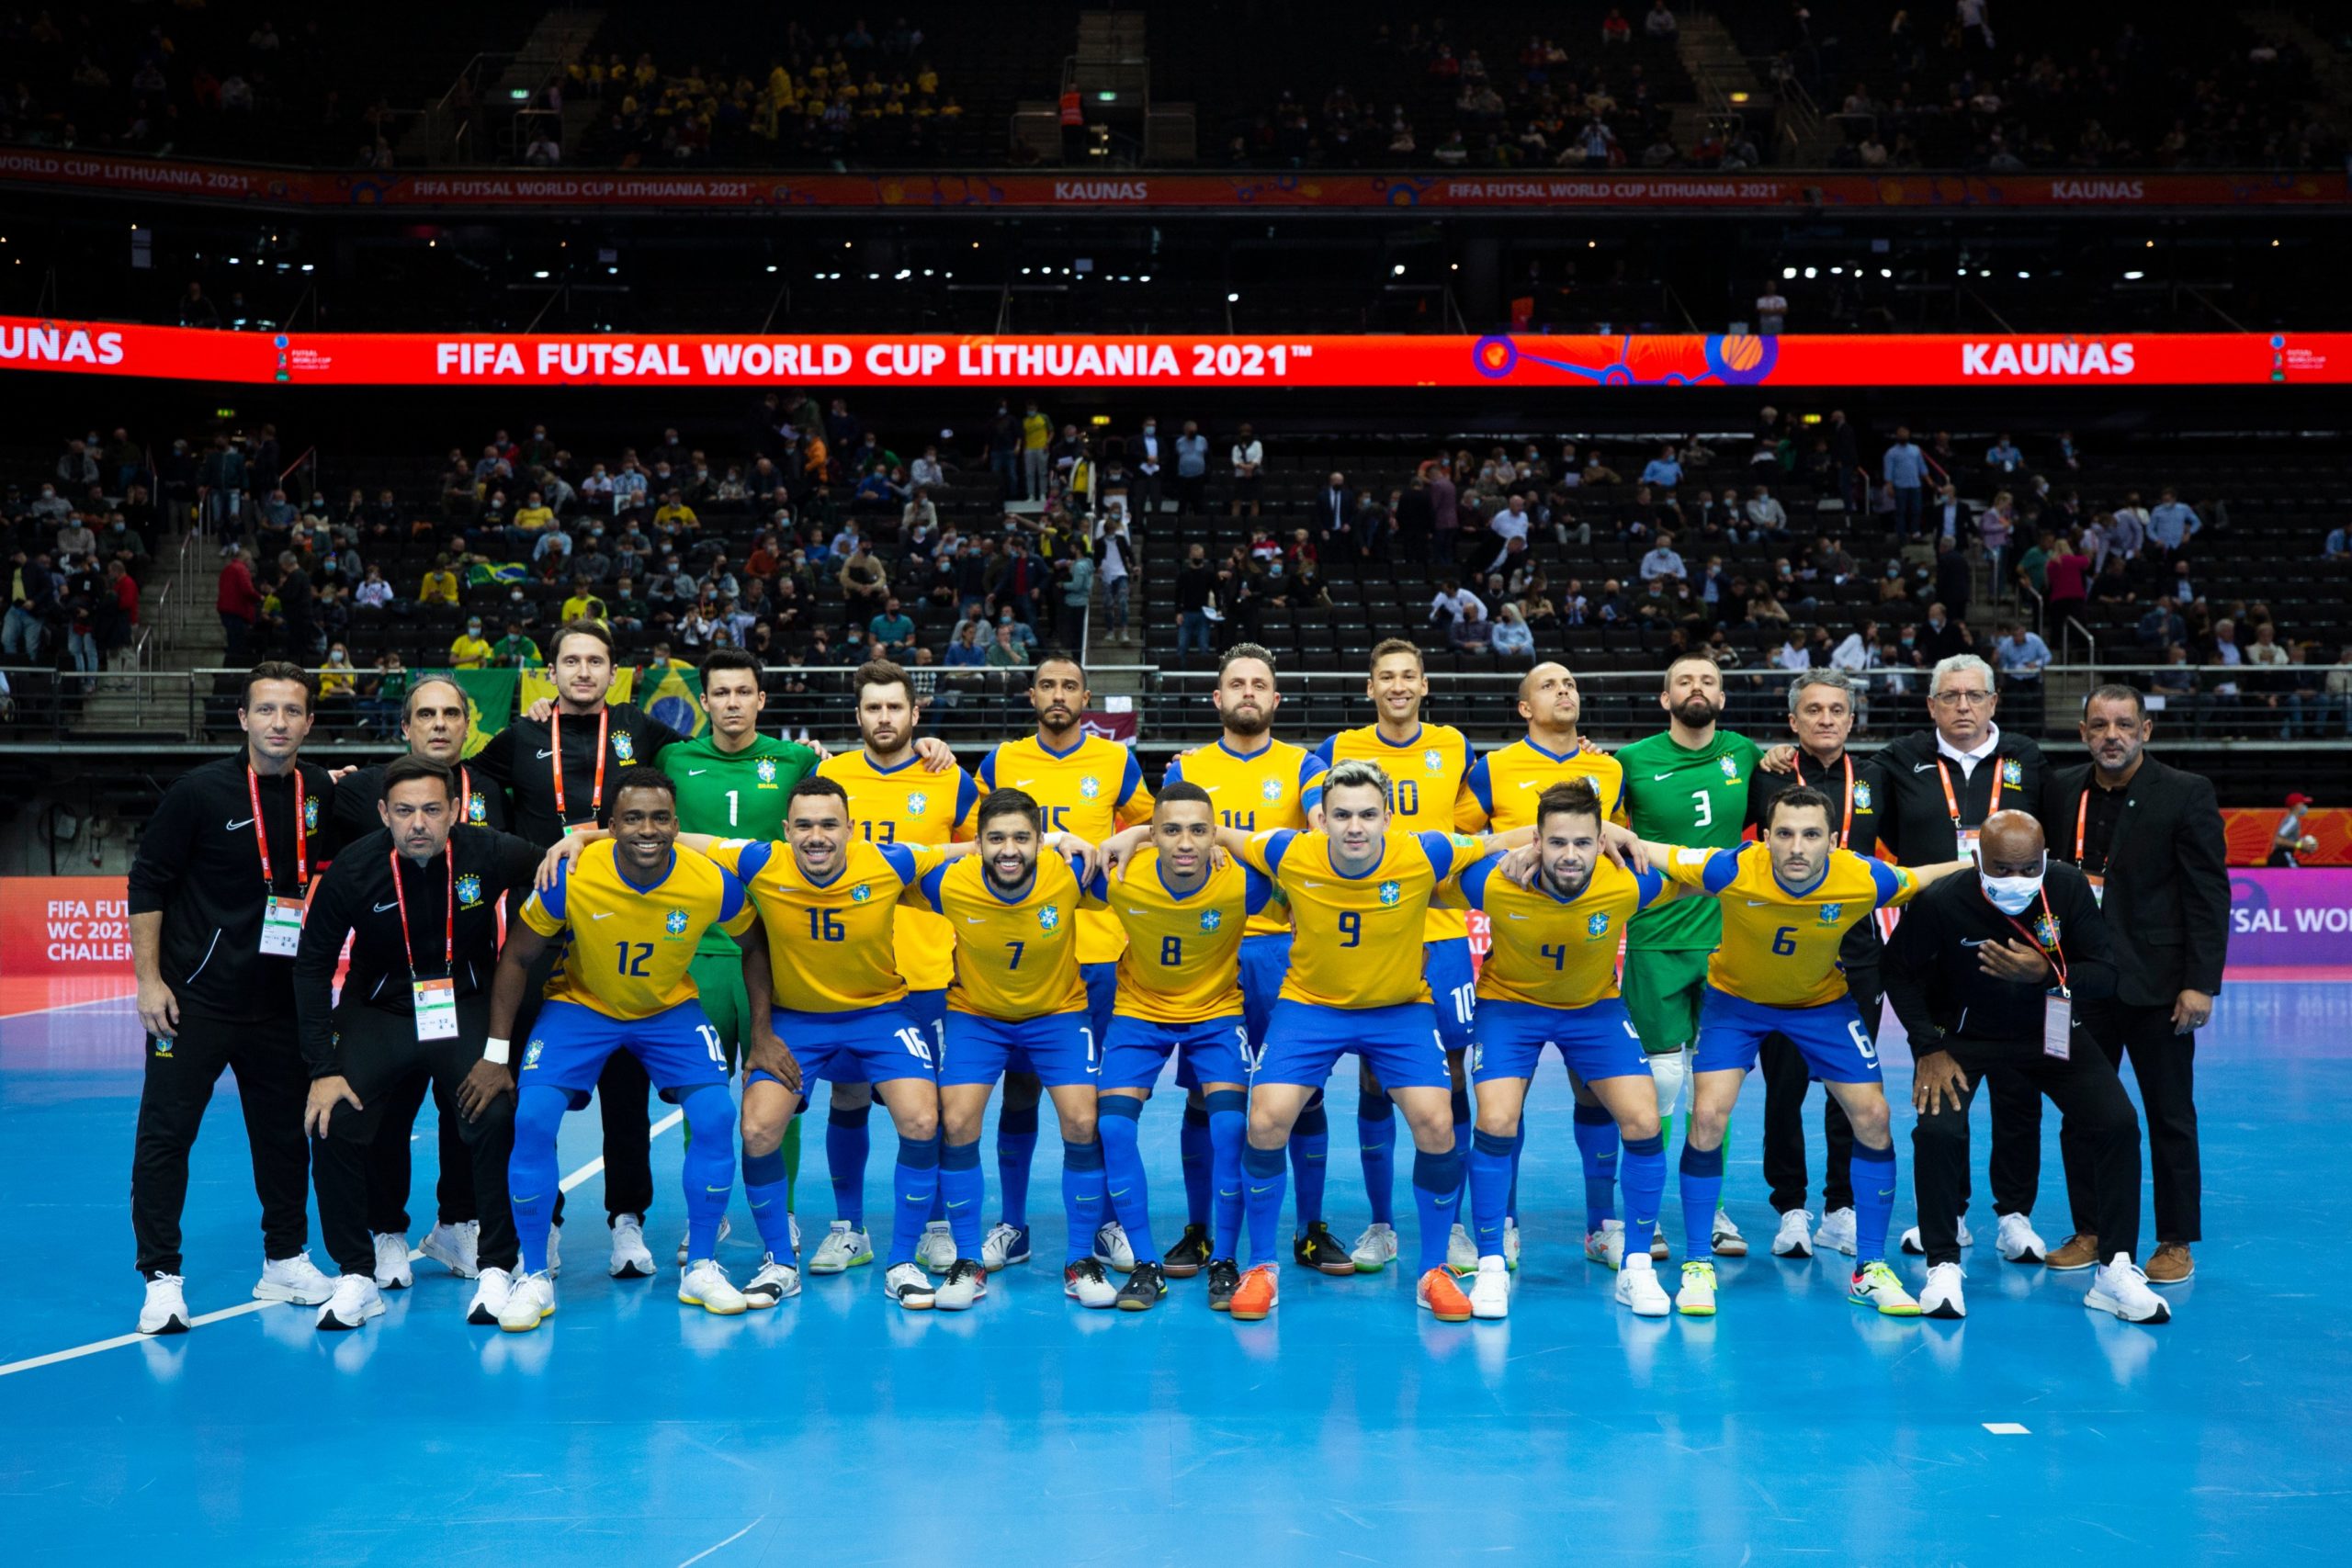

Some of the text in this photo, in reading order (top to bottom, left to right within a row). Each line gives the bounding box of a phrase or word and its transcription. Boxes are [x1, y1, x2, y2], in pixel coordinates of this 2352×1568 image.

[62, 160, 101, 176] CUP
[104, 163, 203, 186] LITHUANIA
[414, 182, 448, 196] FIFA
[452, 182, 512, 196] FUTSAL
[516, 182, 578, 196] WORLD
[582, 182, 615, 197] CUP
[617, 182, 706, 197] LITHUANIA
[1055, 182, 1148, 200] KAUNAS
[1449, 183, 1484, 197] FIFA
[1487, 183, 1546, 197] FUTSAL
[1549, 183, 1611, 197] WORLD
[1613, 183, 1646, 197] CUP
[1649, 183, 1736, 197] LITHUANIA
[2052, 181, 2144, 199] KAUNAS
[436, 343, 526, 376] FIFA
[537, 343, 691, 376] FUTSAL
[700, 343, 853, 377] WORLD
[865, 344, 946, 377] CUP
[958, 344, 1181, 377] LITHUANIA
[1962, 342, 2135, 376] KAUNAS
[725, 790, 739, 827] 1
[1691, 790, 1712, 827] 3
[48, 900, 90, 919] FIFA
[2230, 908, 2289, 932] SAL
[47, 921, 83, 940] WC
[805, 908, 845, 942] 16
[1339, 911, 1361, 948] 9
[1161, 936, 1182, 965] 8
[1771, 926, 1798, 956] 6
[615, 941, 655, 977] 12
[1005, 942, 1025, 970] 7
[1541, 944, 1566, 970] 4
[893, 1027, 933, 1062] 16
[1080, 1027, 1094, 1062] 7
[1848, 1020, 1876, 1058] 6
